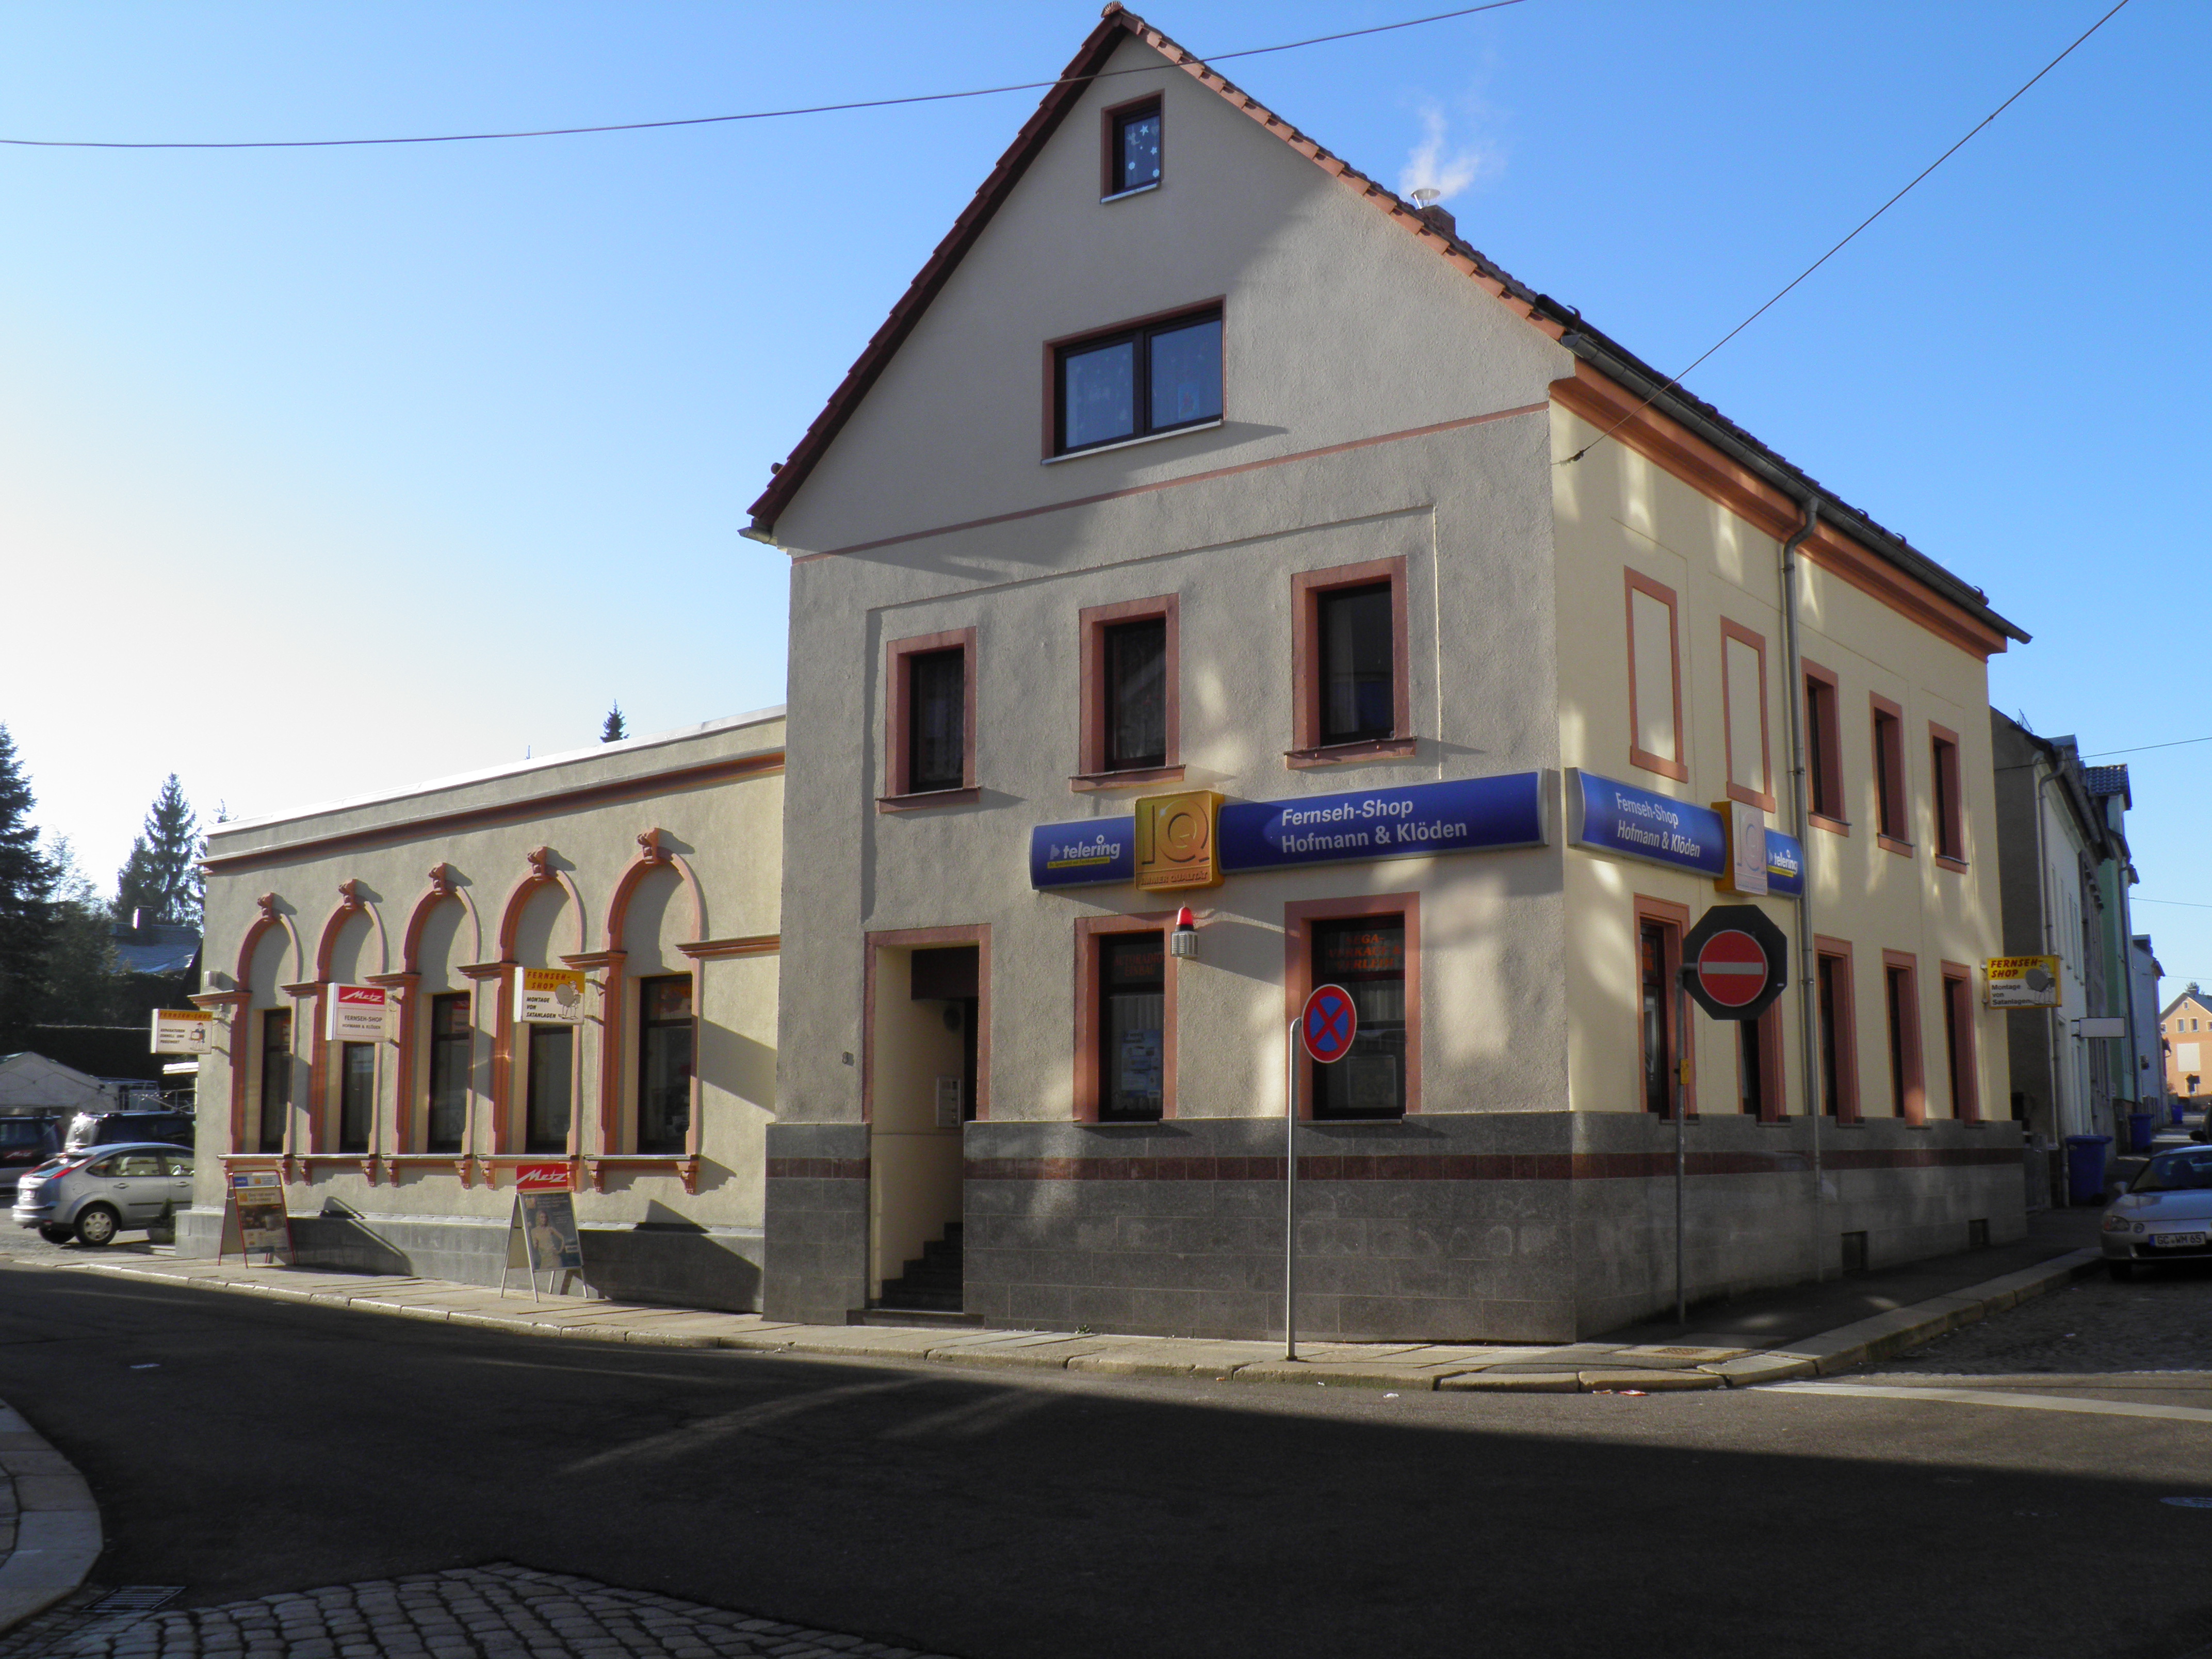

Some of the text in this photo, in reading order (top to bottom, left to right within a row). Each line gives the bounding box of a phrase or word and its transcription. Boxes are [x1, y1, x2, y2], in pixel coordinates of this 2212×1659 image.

[1282, 800, 1413, 826] Fernseh-Shop
[1616, 792, 1678, 828] Fernseh-Shop
[1282, 820, 1467, 853] Hofmann & Klöden
[1617, 820, 1700, 857] Hofmann & Klöden
[1063, 835, 1120, 859] telering
[1774, 850, 1798, 875] telering
[1141, 871, 1208, 885] IMMER QUALITÄT
[1328, 945, 1388, 957] VERKAUF
[1336, 958, 1394, 970] VERLEIH
[1991, 958, 2043, 968] FERNSEH-
[527, 971, 570, 980] FERNSEH-
[1991, 969, 2018, 978] SHOP
[341, 990, 382, 1002] Metz
[516, 1168, 567, 1185] Metz
